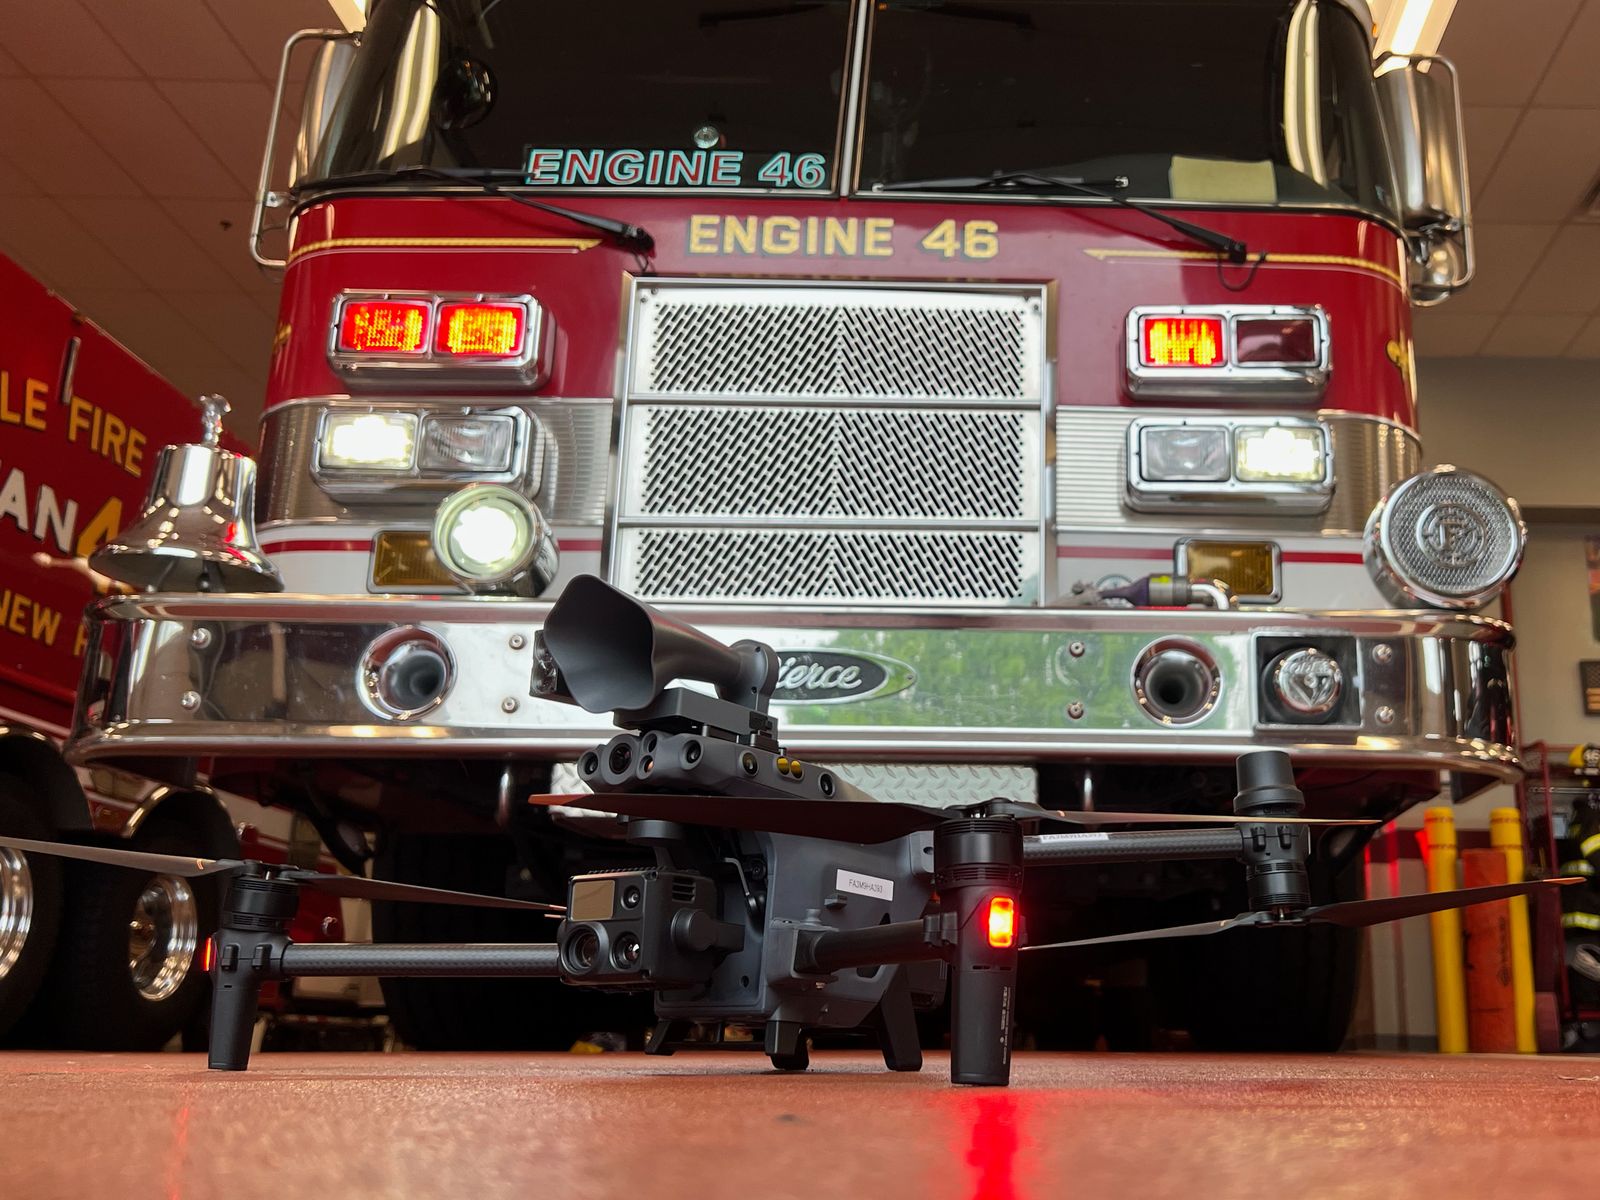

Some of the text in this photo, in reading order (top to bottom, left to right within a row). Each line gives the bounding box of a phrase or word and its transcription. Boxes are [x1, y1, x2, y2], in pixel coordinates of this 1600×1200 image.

[525, 148, 827, 189] ENGINE 46
[688, 214, 999, 259] ENGINE 46
[68, 395, 147, 478] FIRE
[0, 457, 79, 554] AN
[776, 656, 864, 691] ierce
